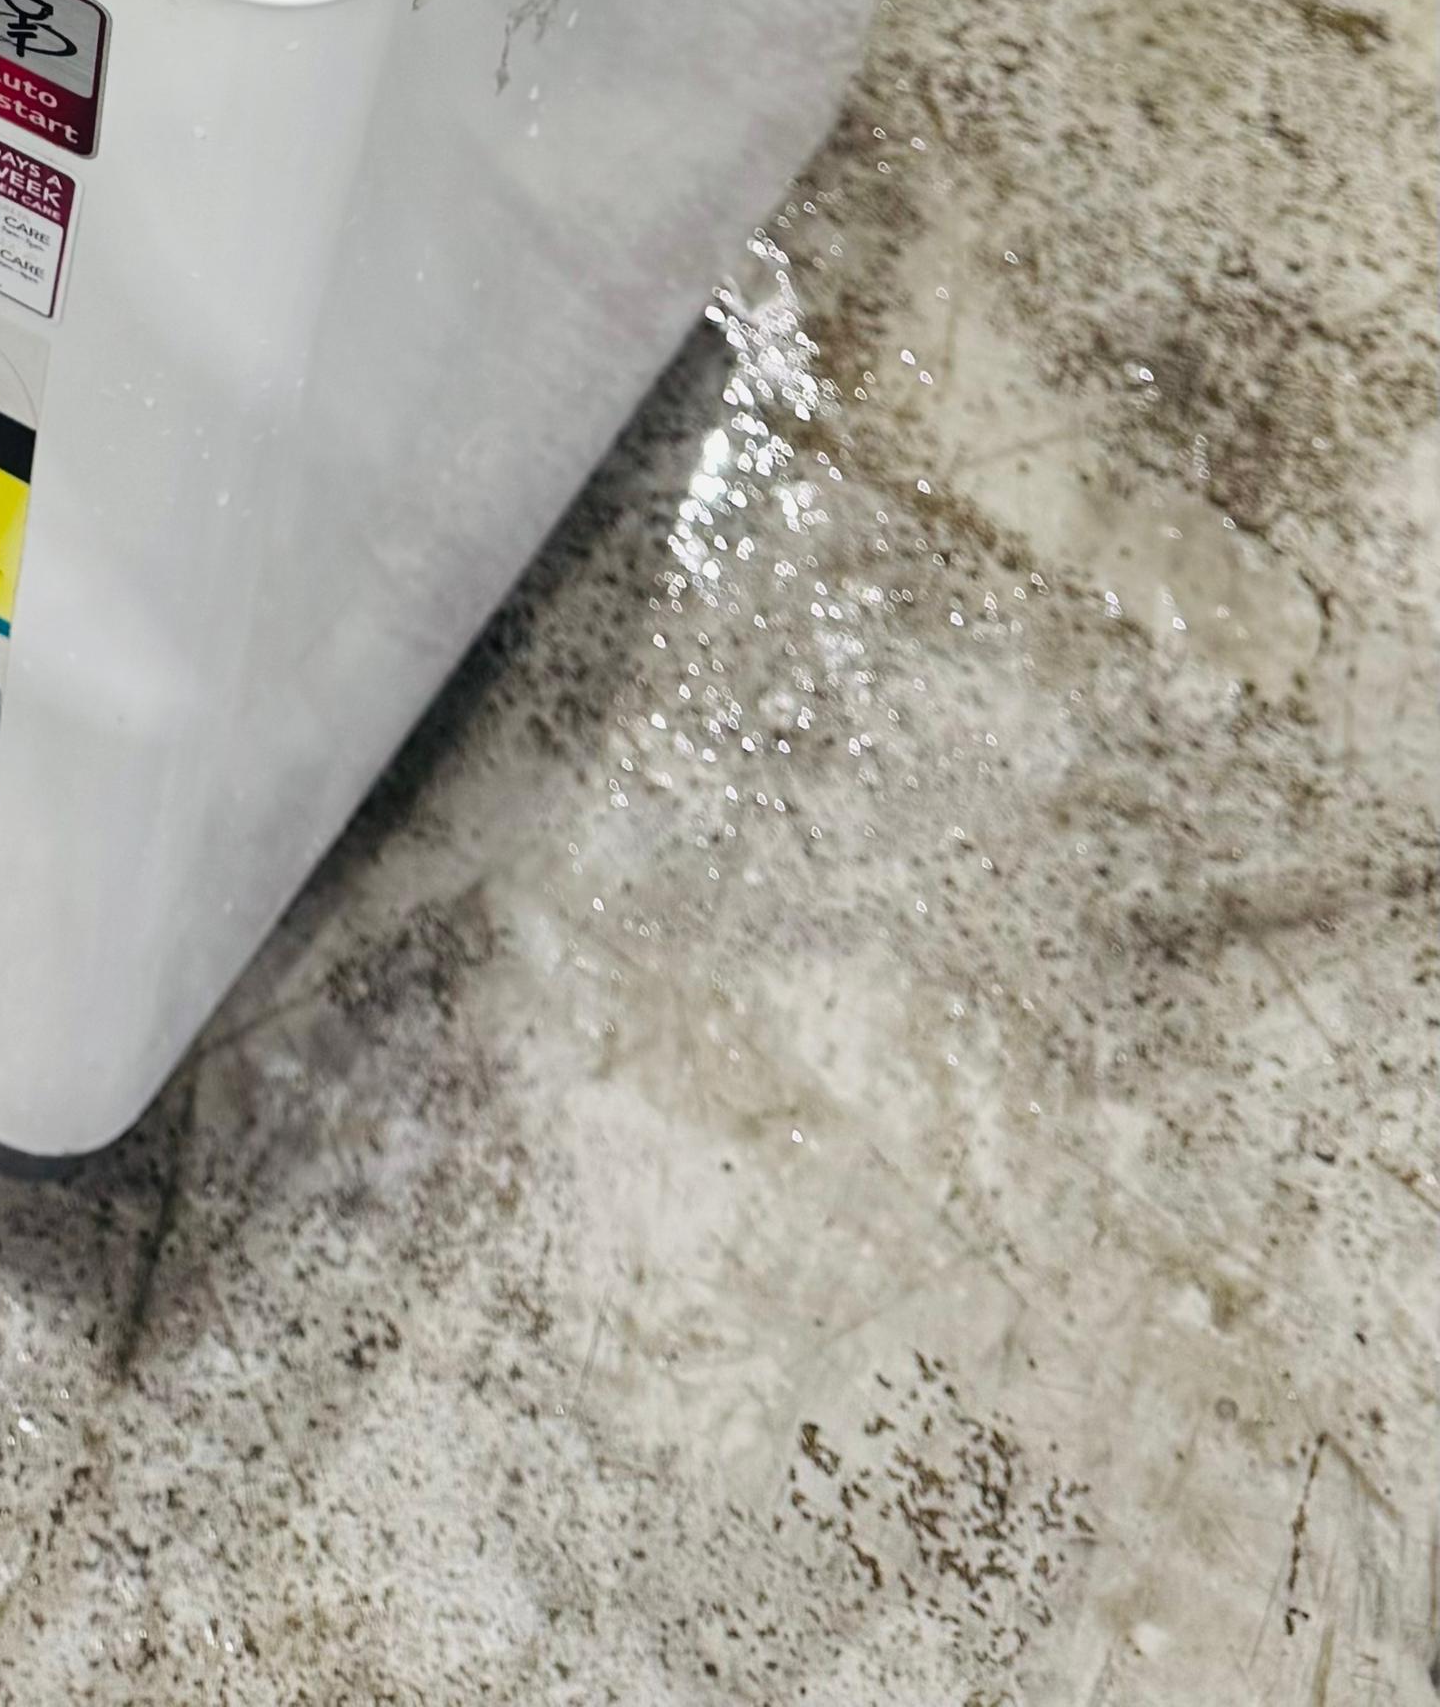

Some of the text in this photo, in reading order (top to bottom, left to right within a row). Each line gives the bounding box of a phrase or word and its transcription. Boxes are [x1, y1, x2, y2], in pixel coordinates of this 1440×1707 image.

[46, 175, 63, 190] A
[21, 194, 61, 220] CARE
[4, 216, 51, 245] CARE
[0, 249, 46, 279] CARE
